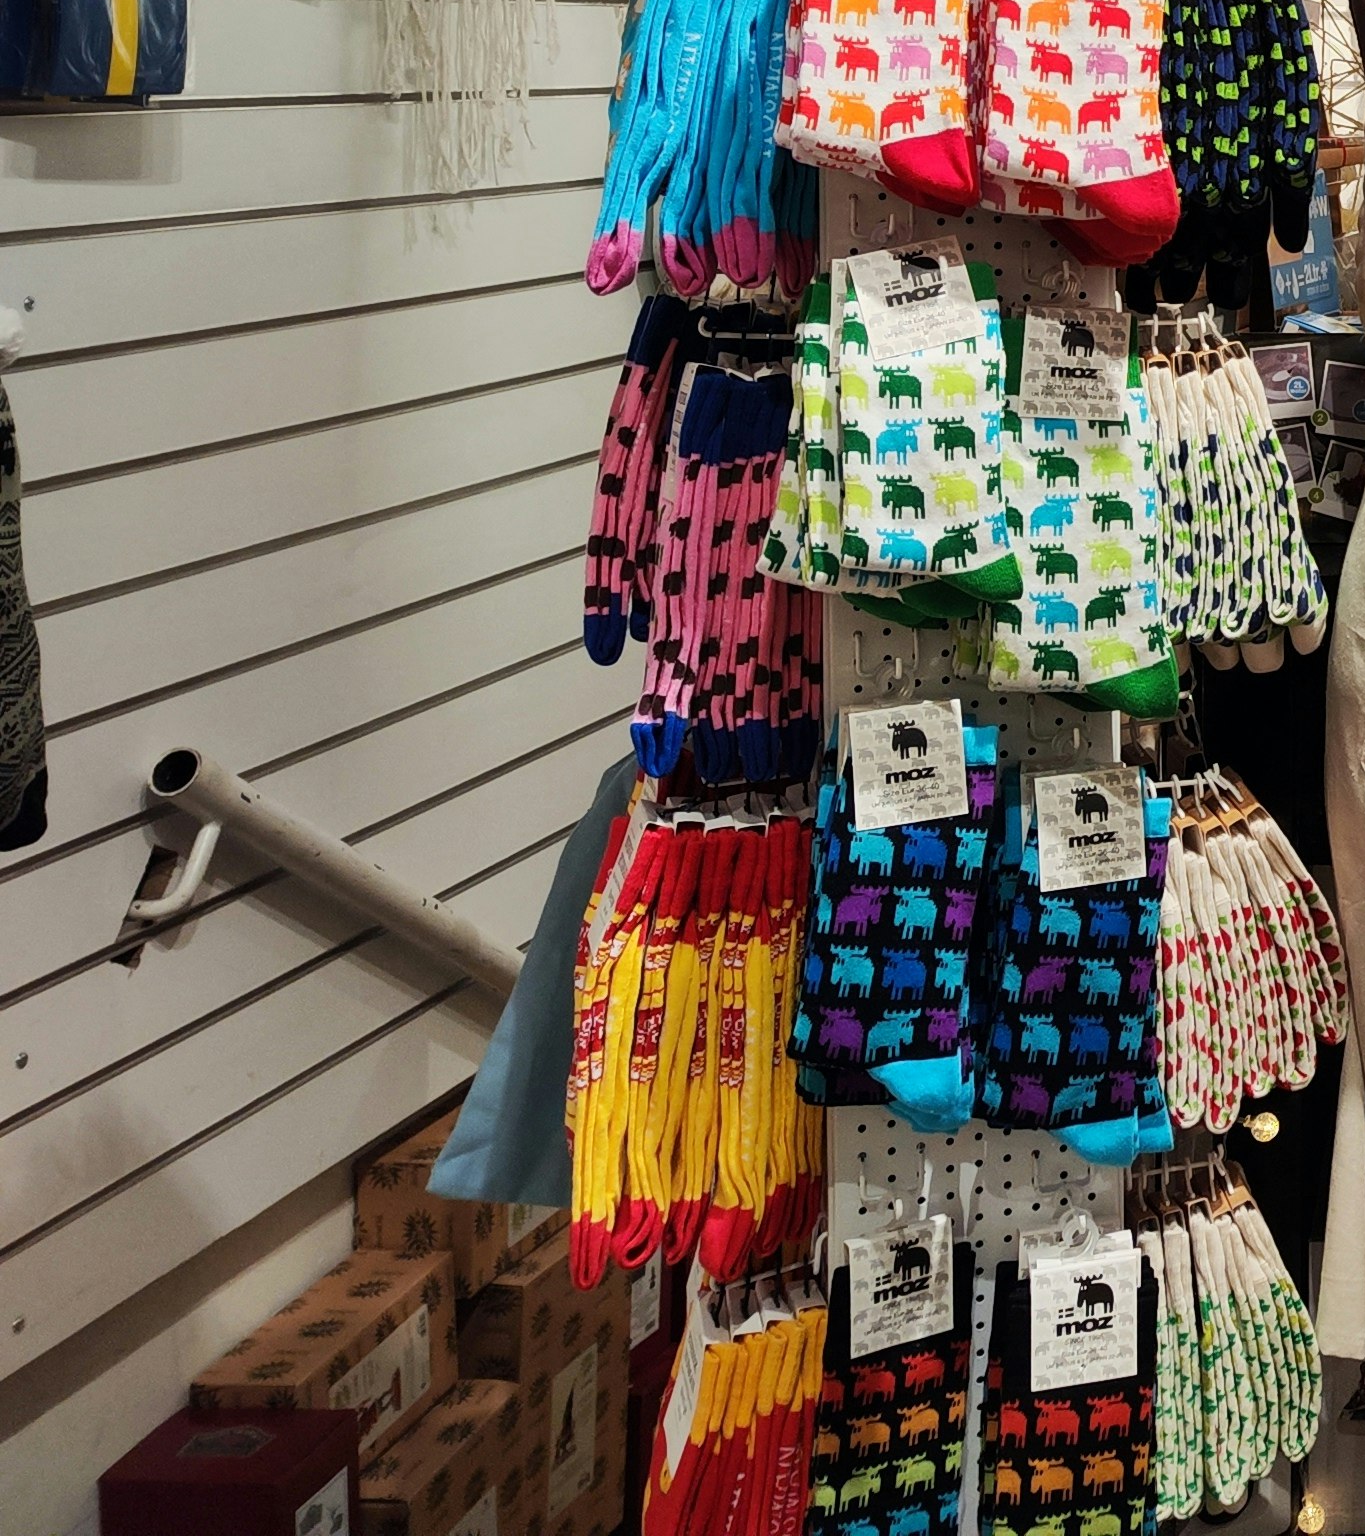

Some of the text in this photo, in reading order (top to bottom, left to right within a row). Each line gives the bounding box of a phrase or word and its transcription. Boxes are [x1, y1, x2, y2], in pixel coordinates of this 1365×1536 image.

[885, 282, 947, 308] moz
[1050, 365, 1098, 380] moz
[885, 767, 936, 785] moz
[1069, 831, 1117, 849] moz
[873, 1275, 932, 1305] moz
[1056, 1315, 1114, 1337] moz
